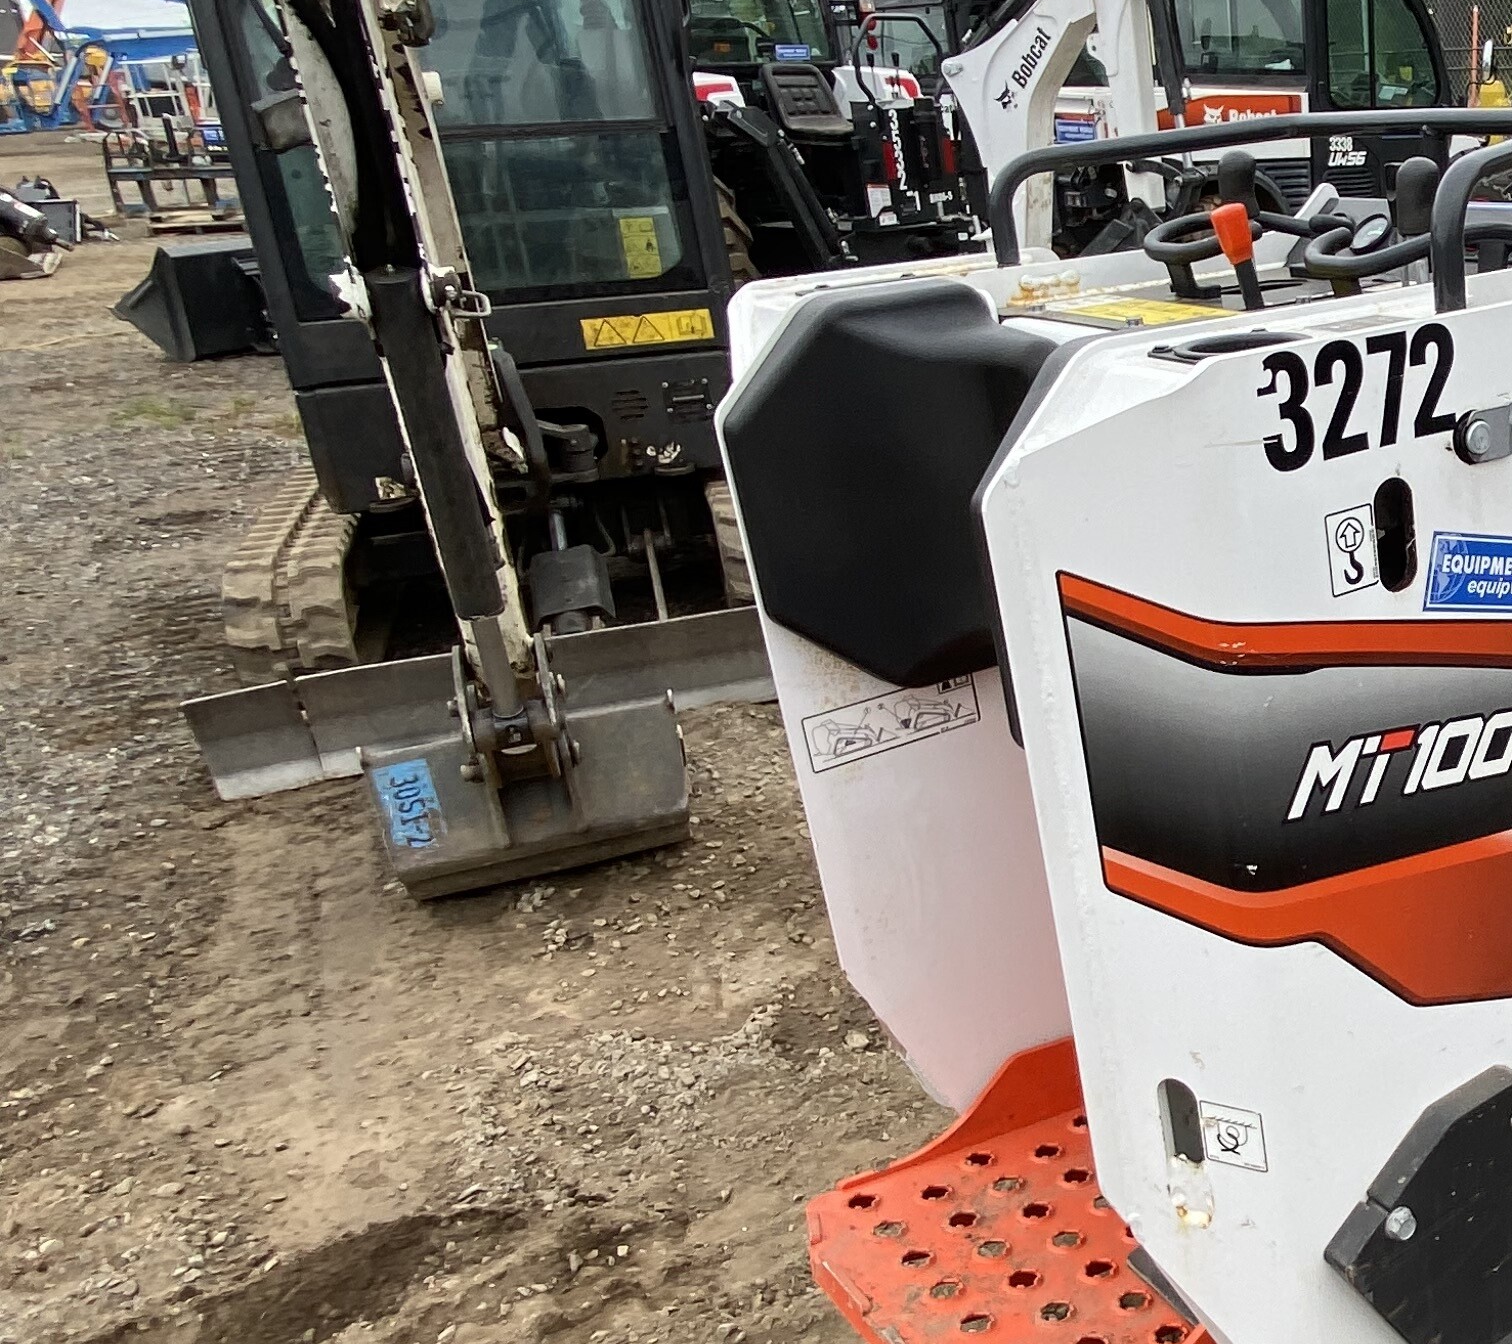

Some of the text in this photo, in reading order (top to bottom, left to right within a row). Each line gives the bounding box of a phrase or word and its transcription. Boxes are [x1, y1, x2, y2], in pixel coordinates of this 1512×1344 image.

[1011, 26, 1052, 89] Bobcat
[1228, 108, 1277, 122] Bob
[1328, 136, 1353, 152] 3338
[1257, 322, 1456, 472] 3272
